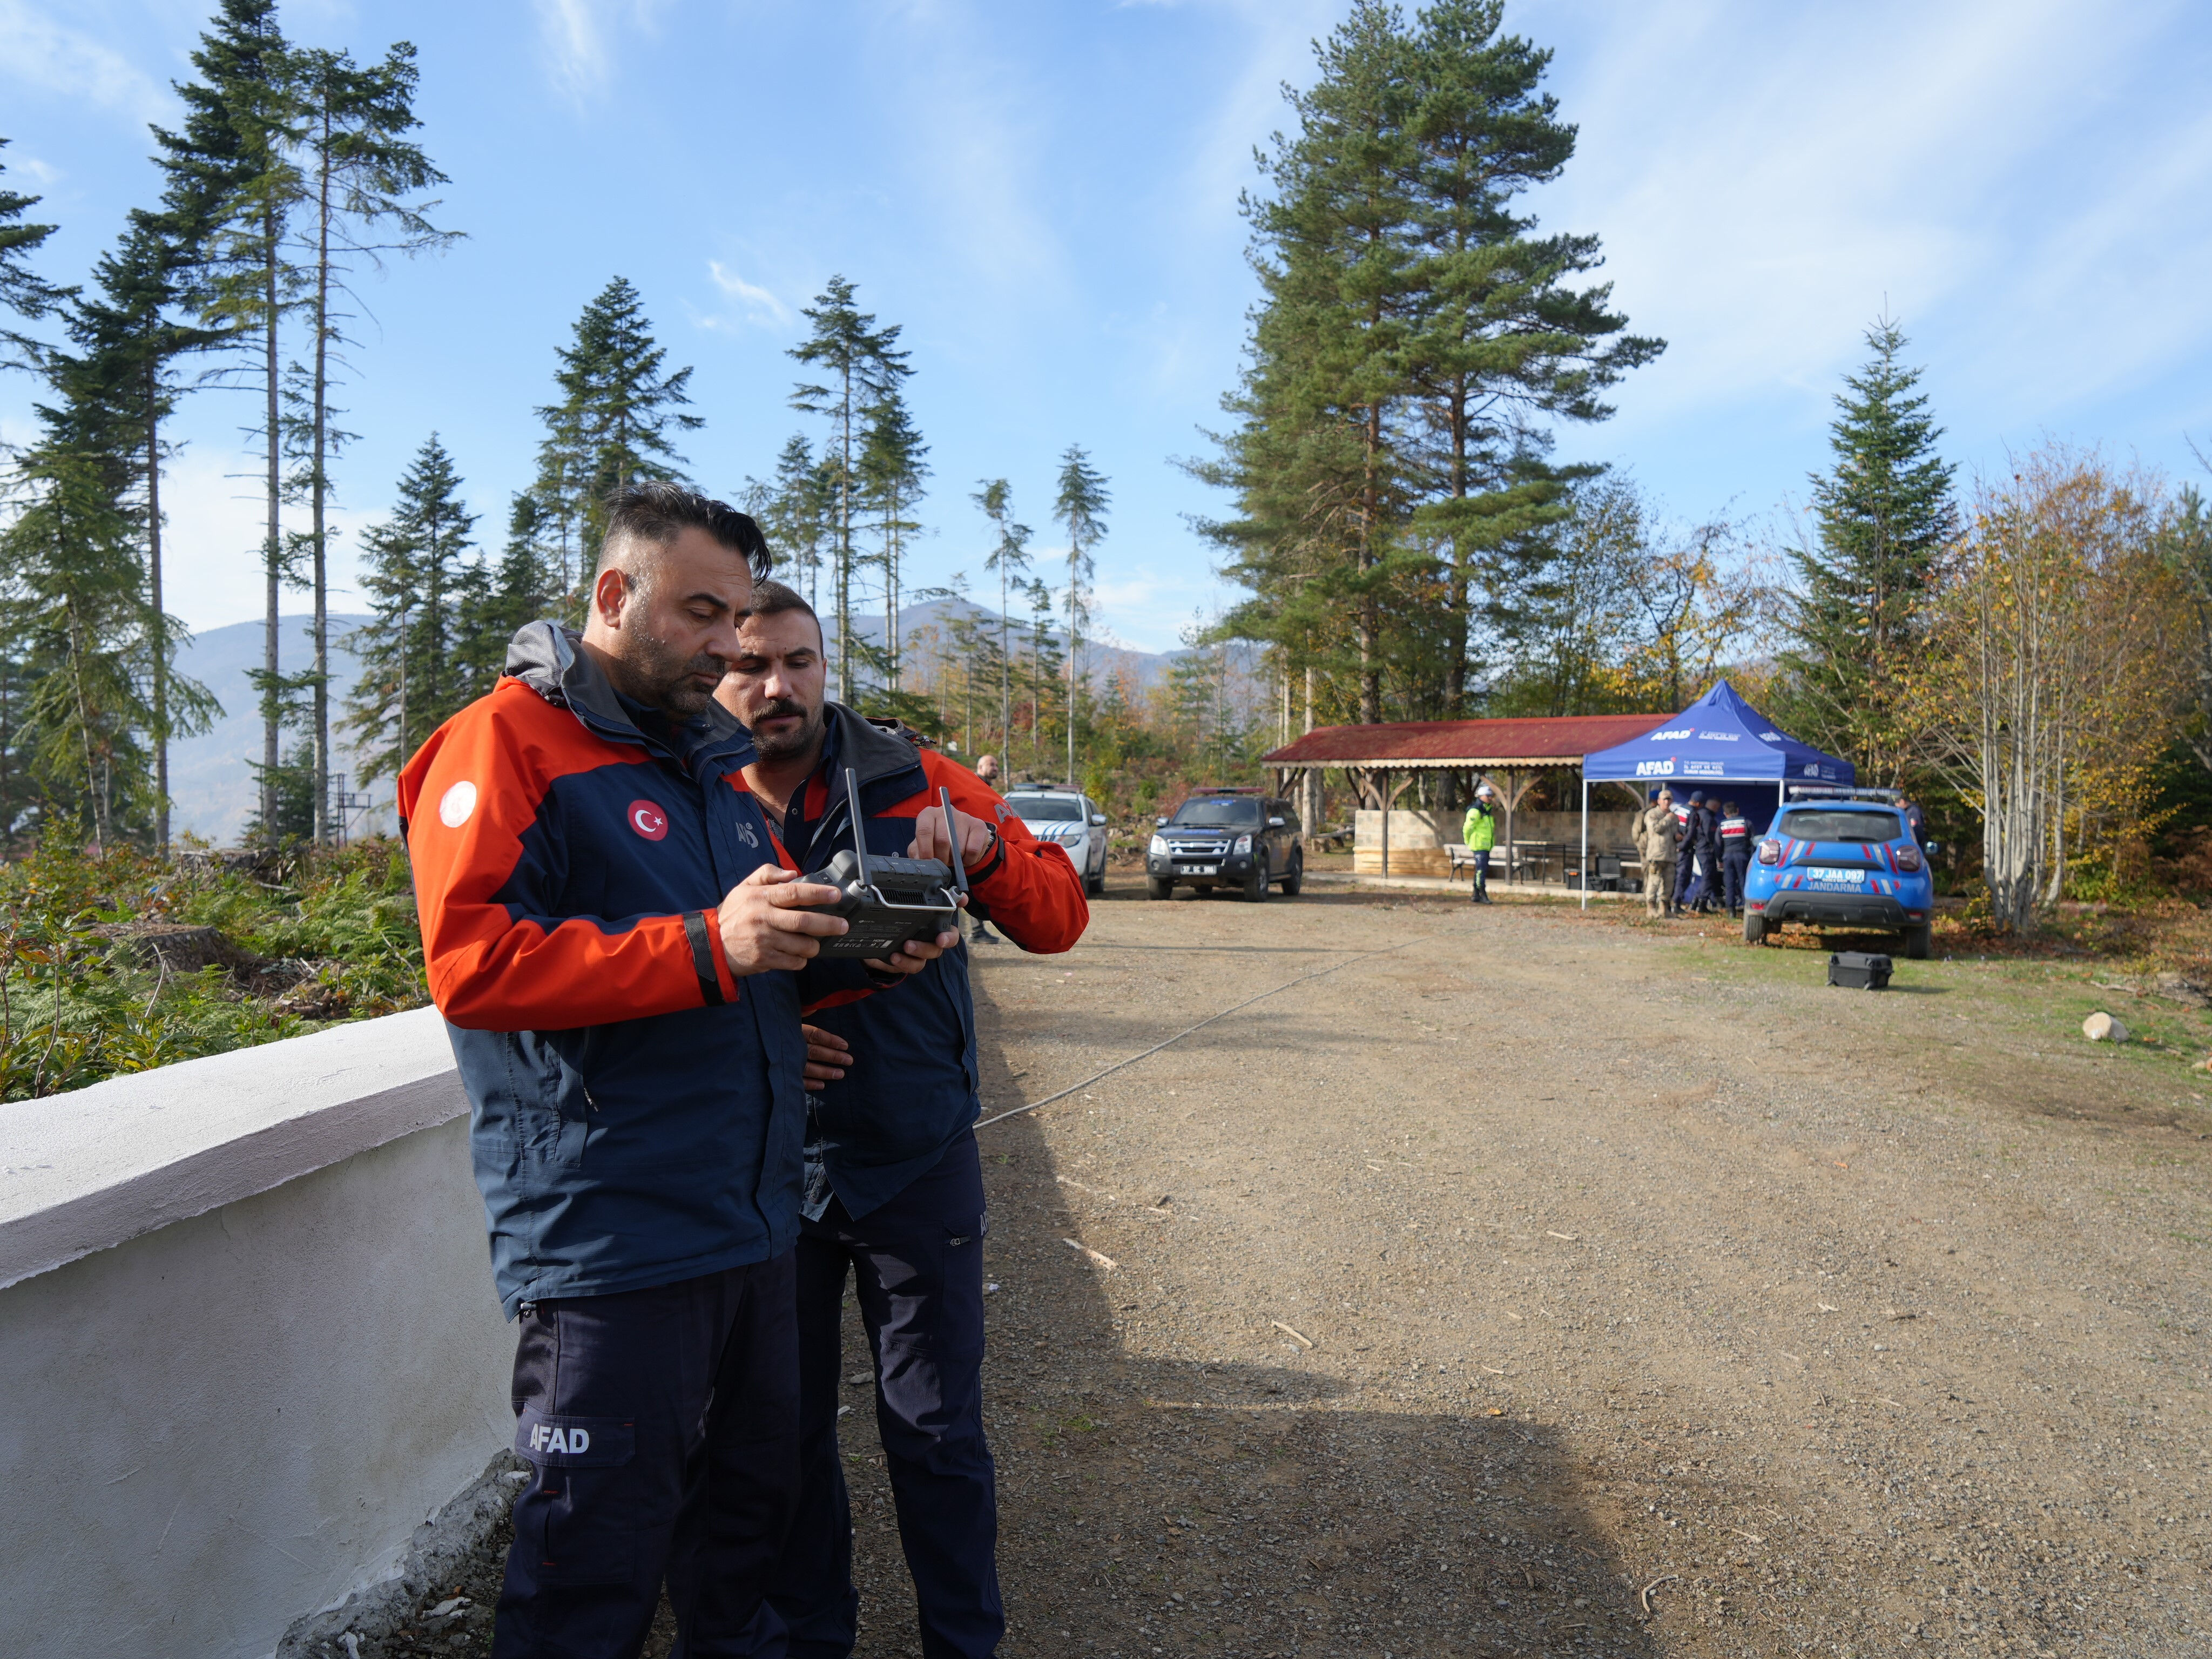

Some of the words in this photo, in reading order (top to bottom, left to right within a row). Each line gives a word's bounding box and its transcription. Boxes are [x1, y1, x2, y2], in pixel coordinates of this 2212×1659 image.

[1650, 730, 1691, 741] AFAD
[1636, 760, 1674, 776] AFAD
[1813, 868, 1825, 879] 37
[1825, 869, 1843, 880] JAA
[1808, 881, 1862, 893] JANDARMA
[529, 1423, 590, 1454] AFAD
